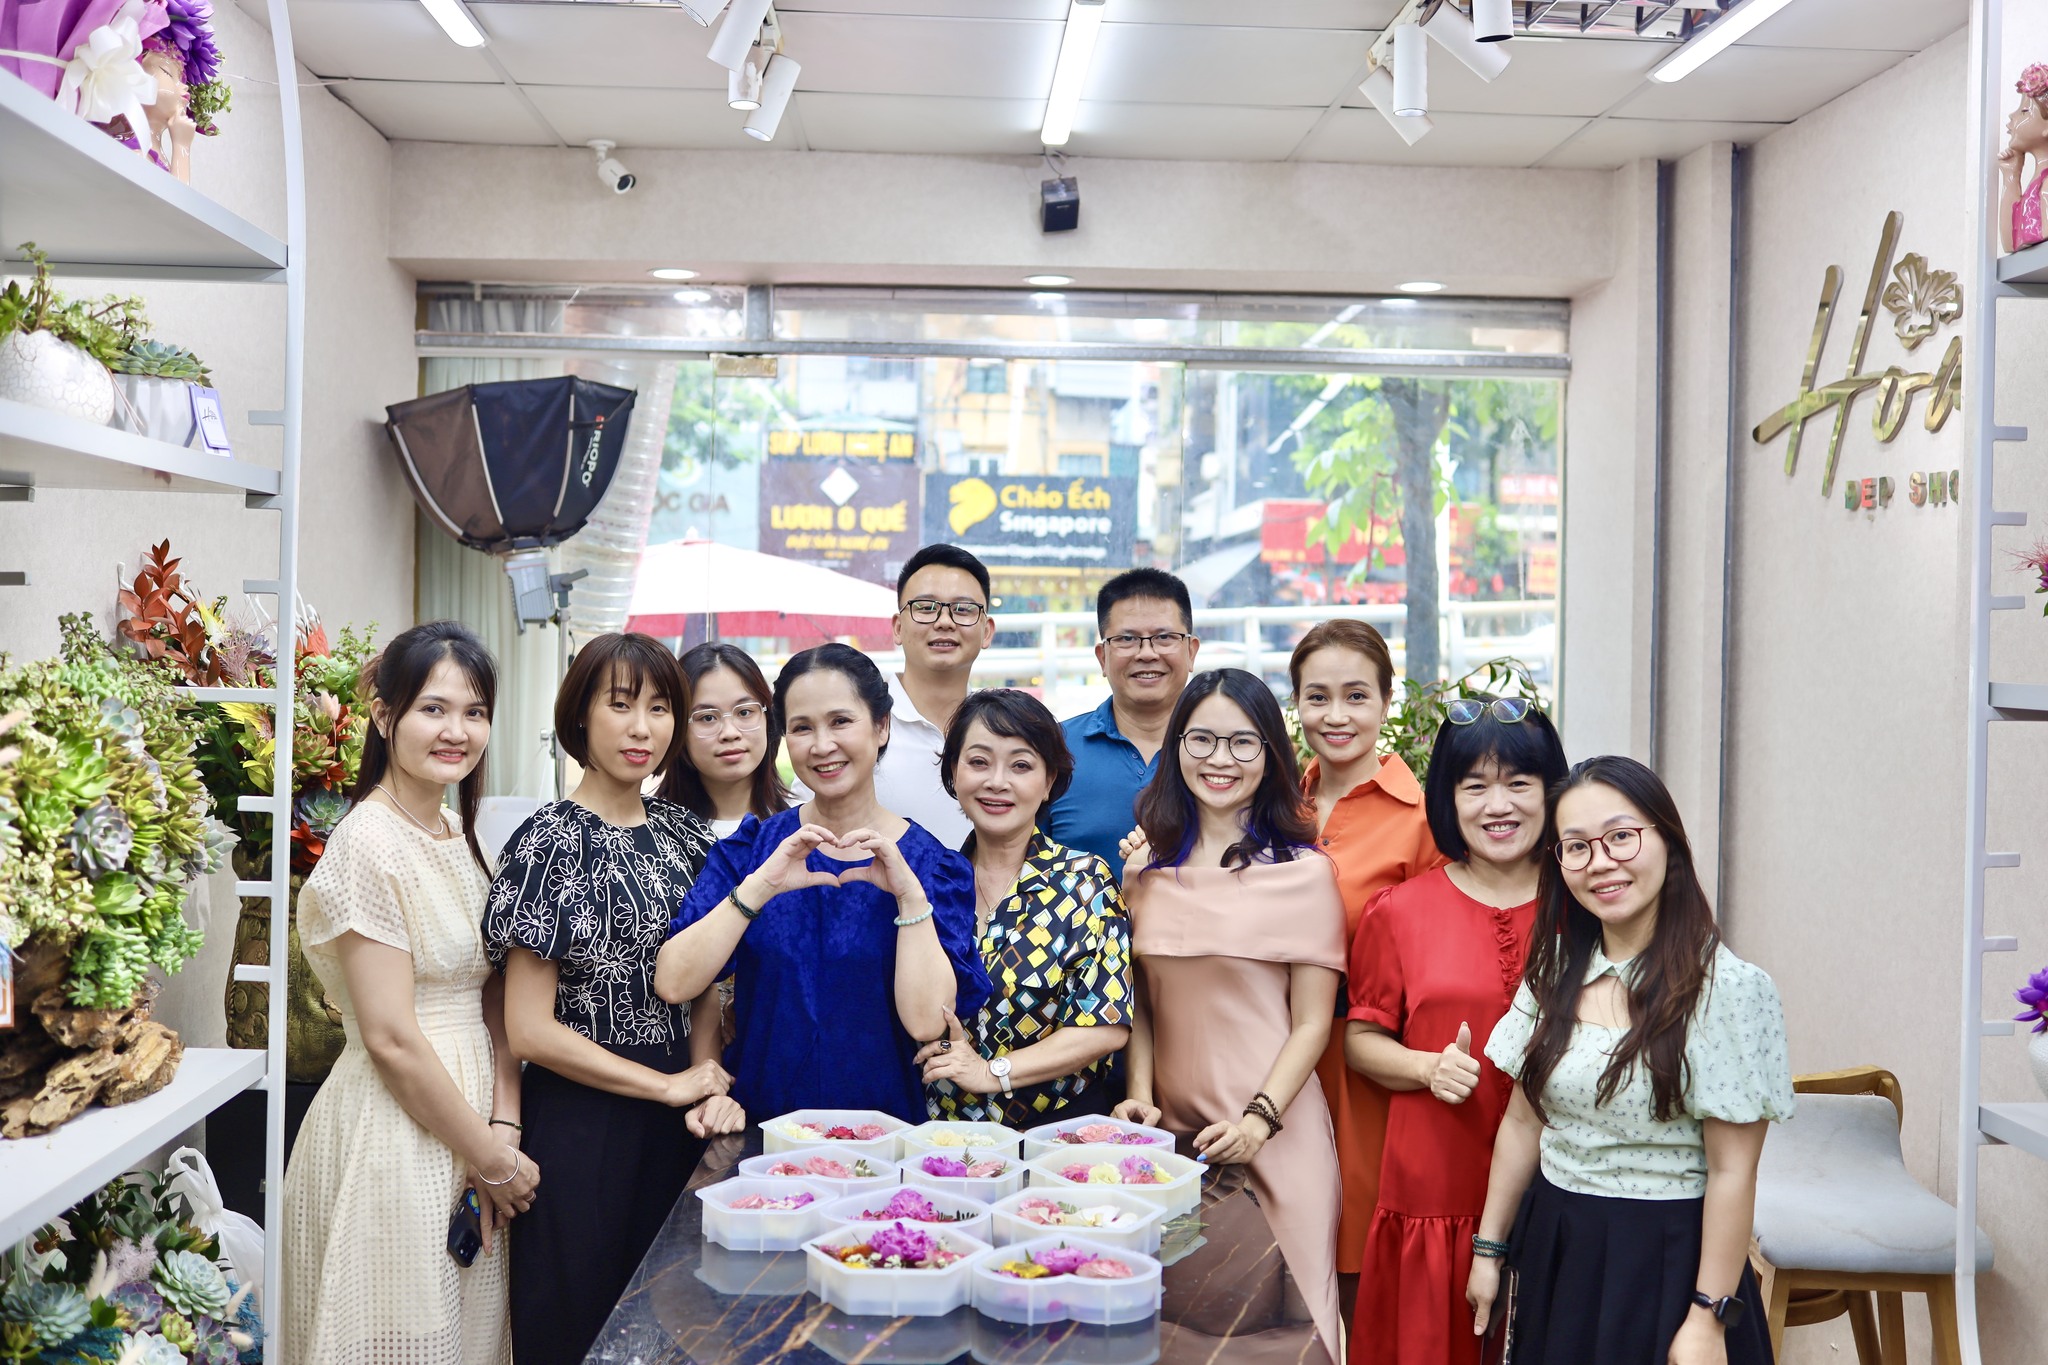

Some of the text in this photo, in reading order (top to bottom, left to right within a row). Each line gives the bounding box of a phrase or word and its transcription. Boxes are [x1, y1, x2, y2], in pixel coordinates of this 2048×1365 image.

[1000, 477, 1111, 510] Cháo Ếch
[999, 510, 1112, 538] Singapore
